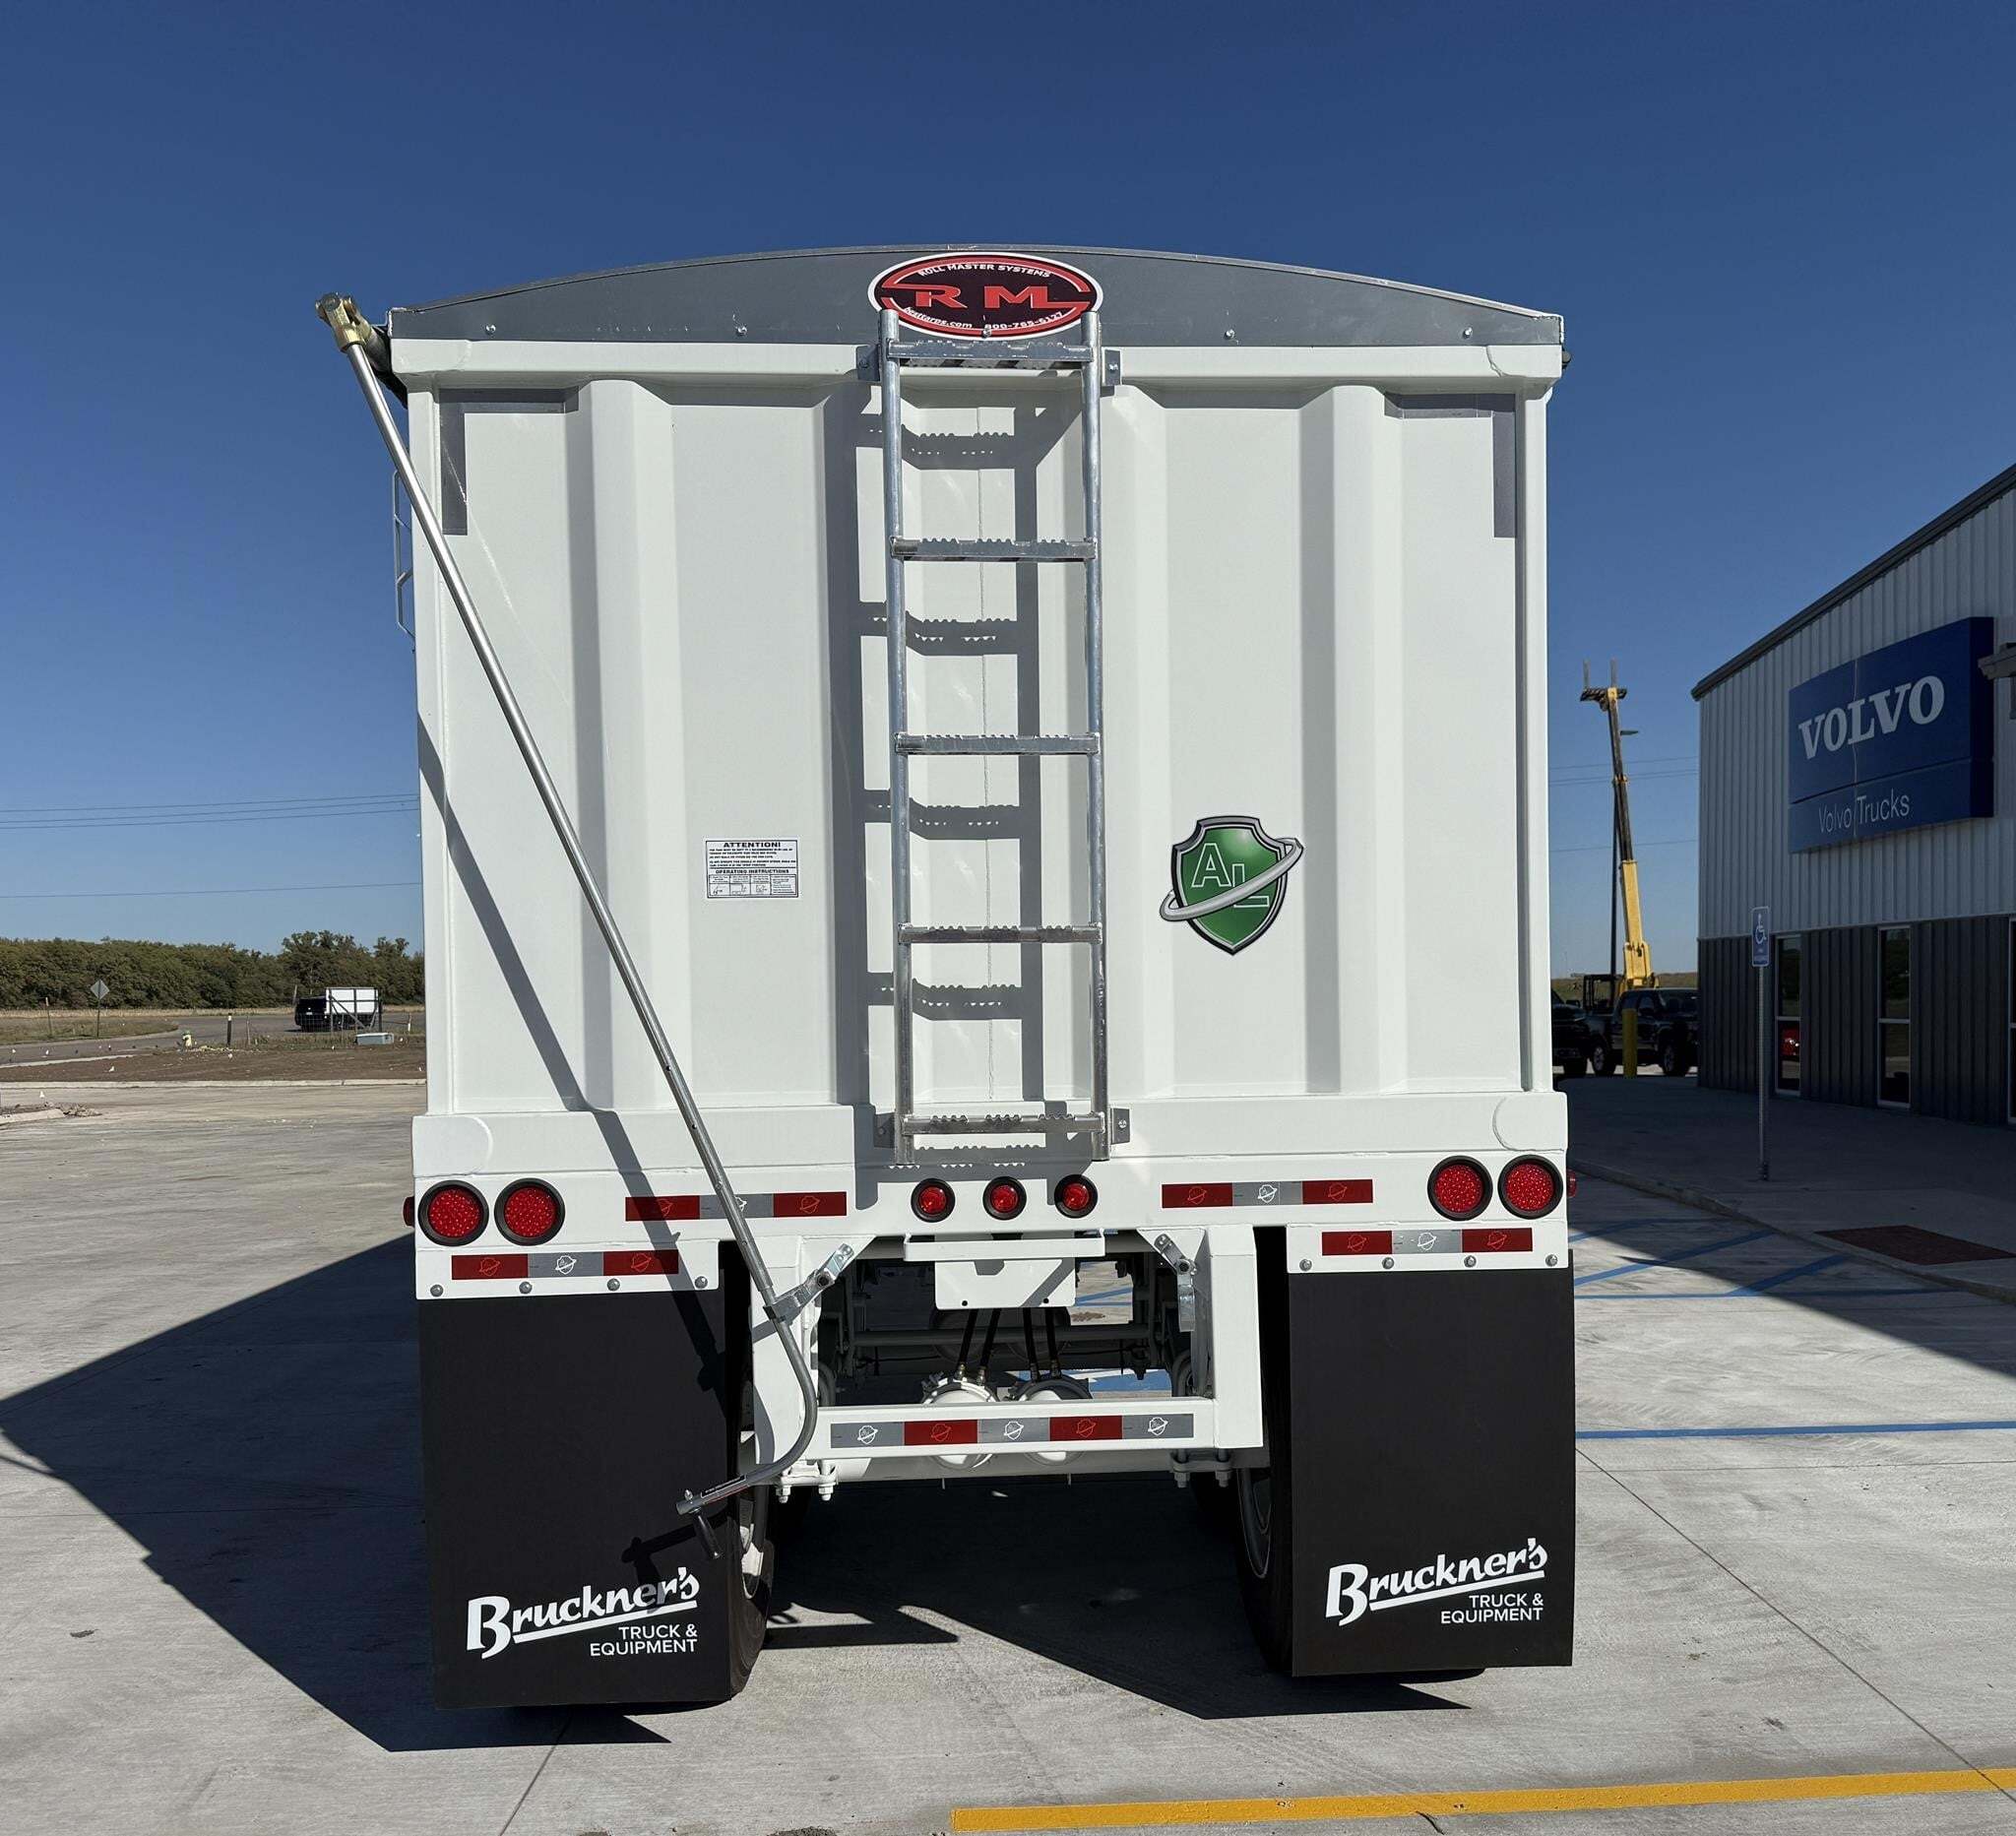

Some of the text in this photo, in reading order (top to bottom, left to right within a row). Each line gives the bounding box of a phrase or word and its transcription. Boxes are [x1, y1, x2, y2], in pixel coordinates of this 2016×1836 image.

[917, 263, 1050, 278] ROLL MASTER SYSTEMS
[1798, 675, 1945, 760] VOLVO
[1818, 787, 1911, 834] Volvo Trucks
[1325, 1538, 1548, 1626] Bruckner's
[1469, 1593, 1544, 1609] TRUCK &
[467, 1567, 700, 1660] Bruckner's
[1440, 1607, 1544, 1624] EQUIPMENT
[618, 1623, 698, 1640] TRUCK &
[590, 1638, 698, 1657] EQUIPMENT
